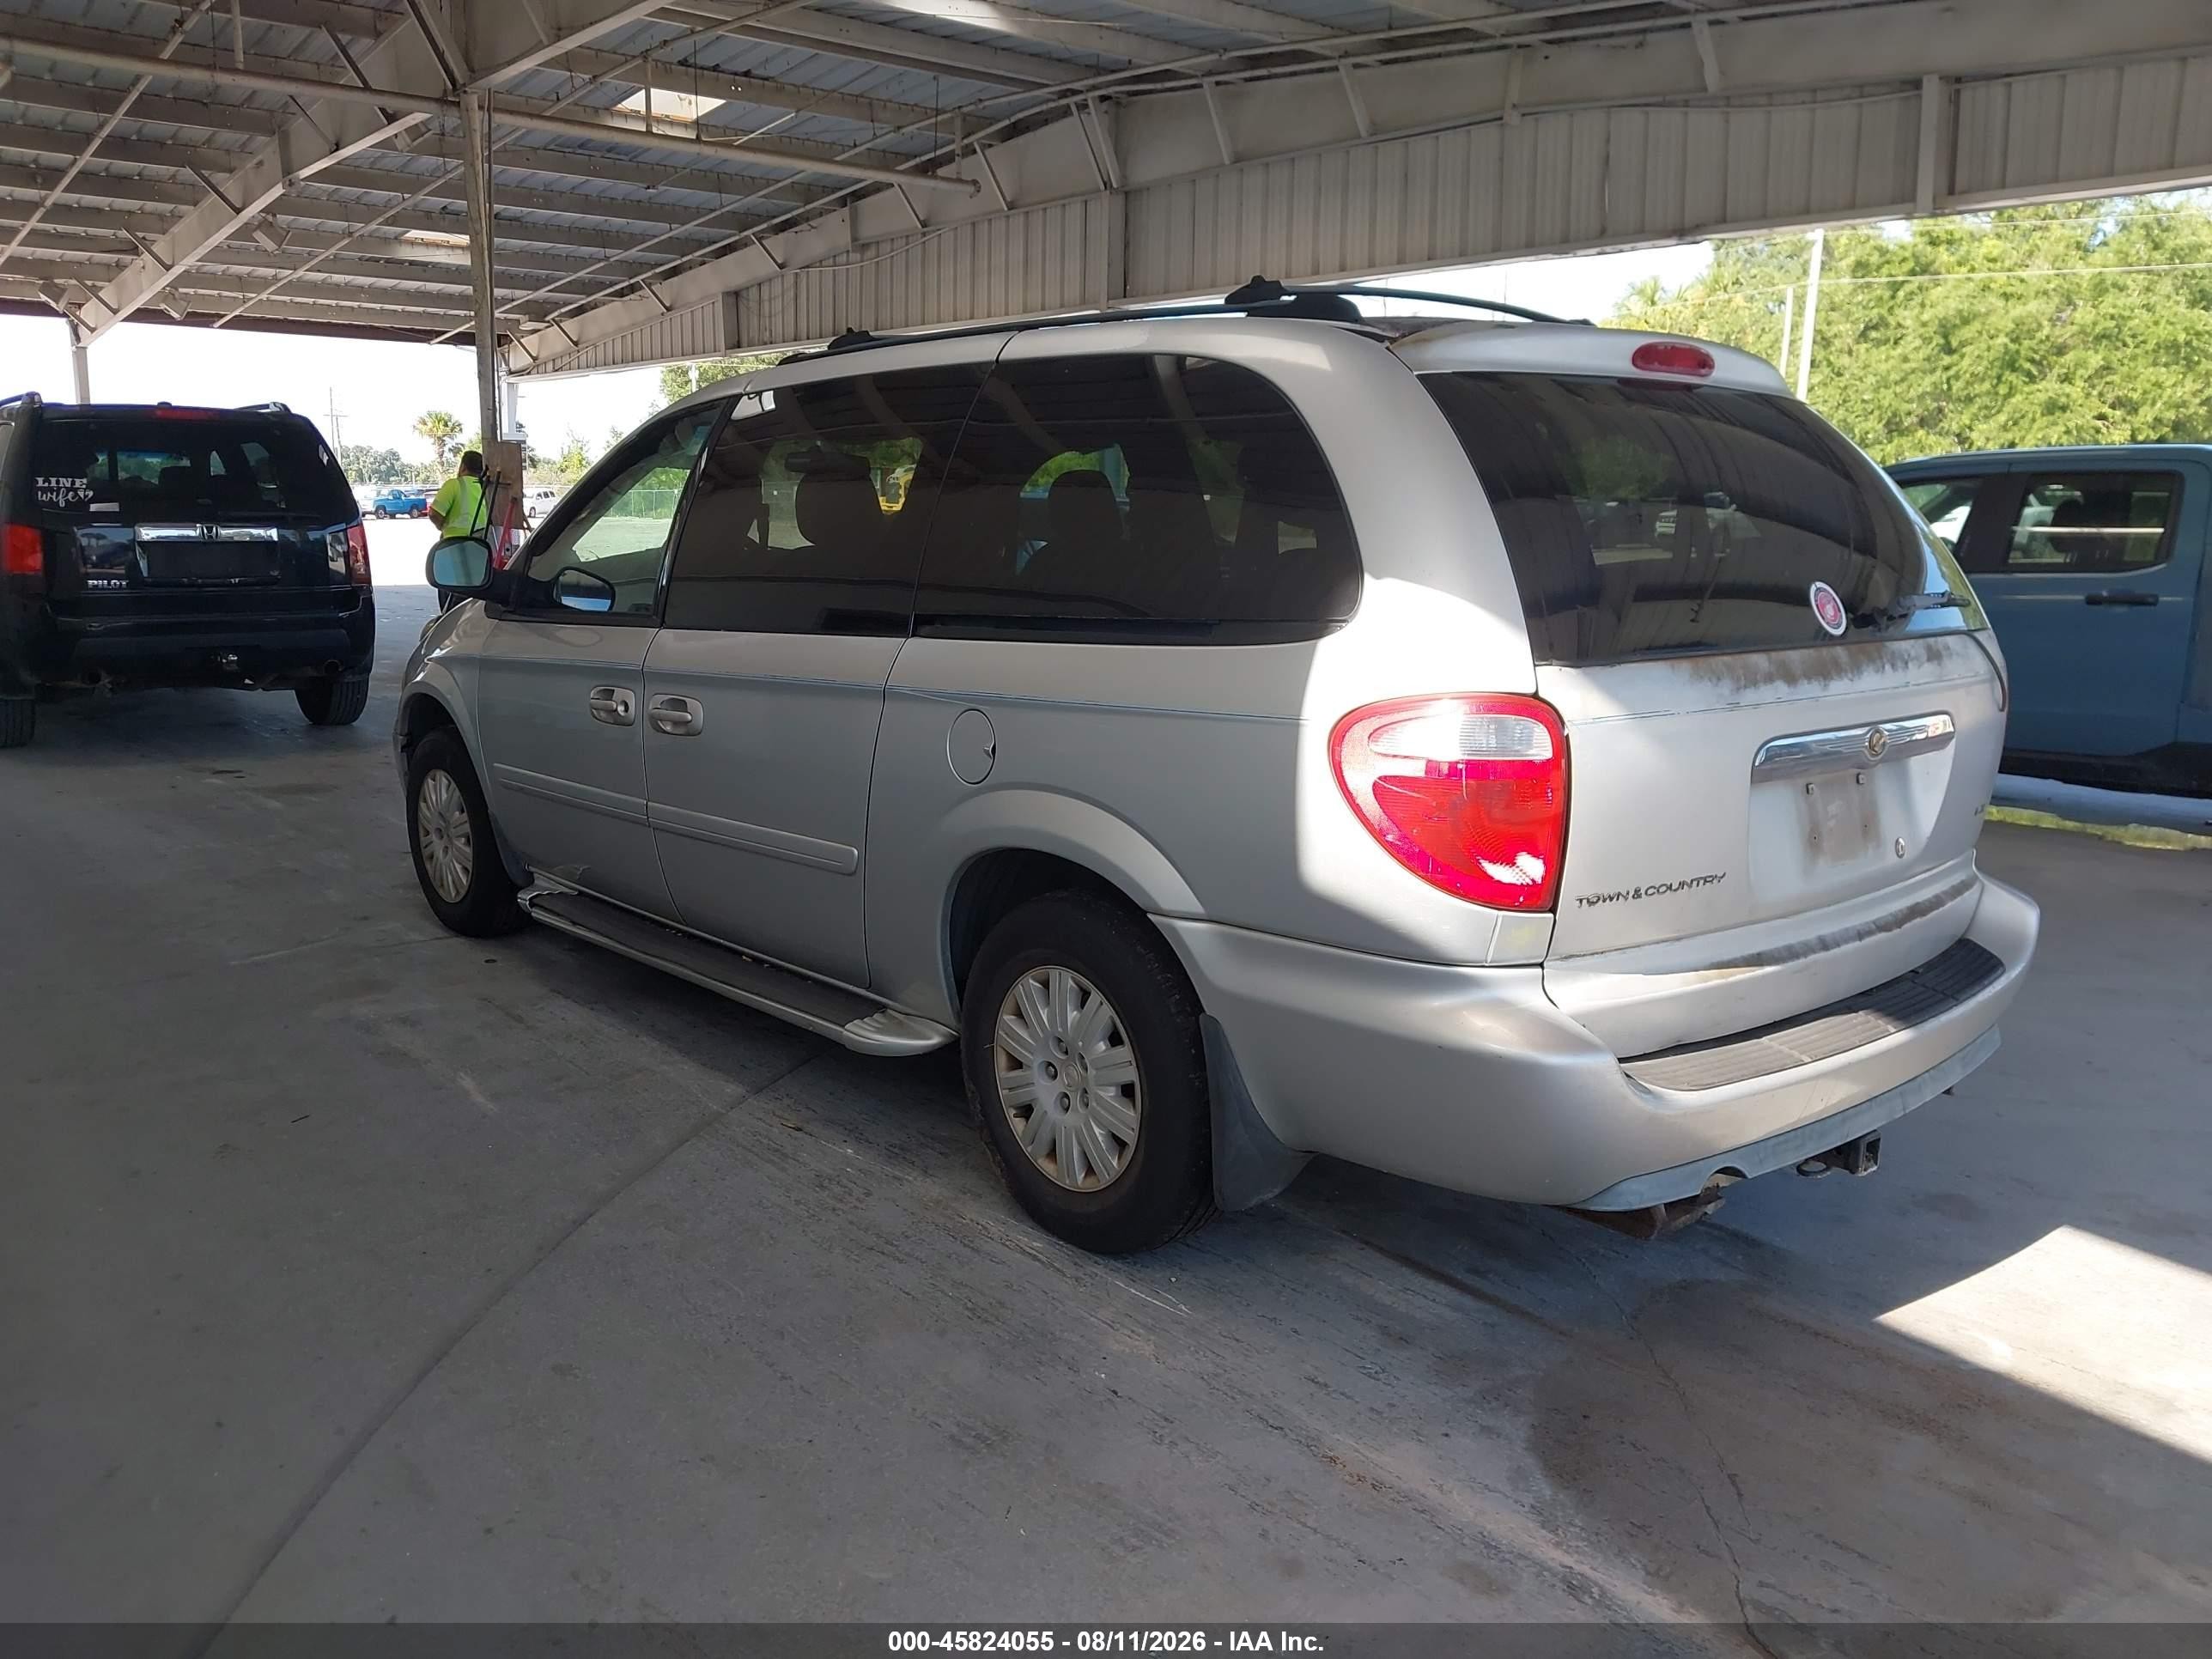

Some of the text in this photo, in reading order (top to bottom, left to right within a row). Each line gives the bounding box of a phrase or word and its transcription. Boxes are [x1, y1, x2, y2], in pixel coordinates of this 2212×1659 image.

[34, 477, 88, 489] LINE
[37, 487, 79, 507] wife
[87, 580, 129, 589] PILOT
[1575, 872, 1726, 908] TOWN & COUNTRY
